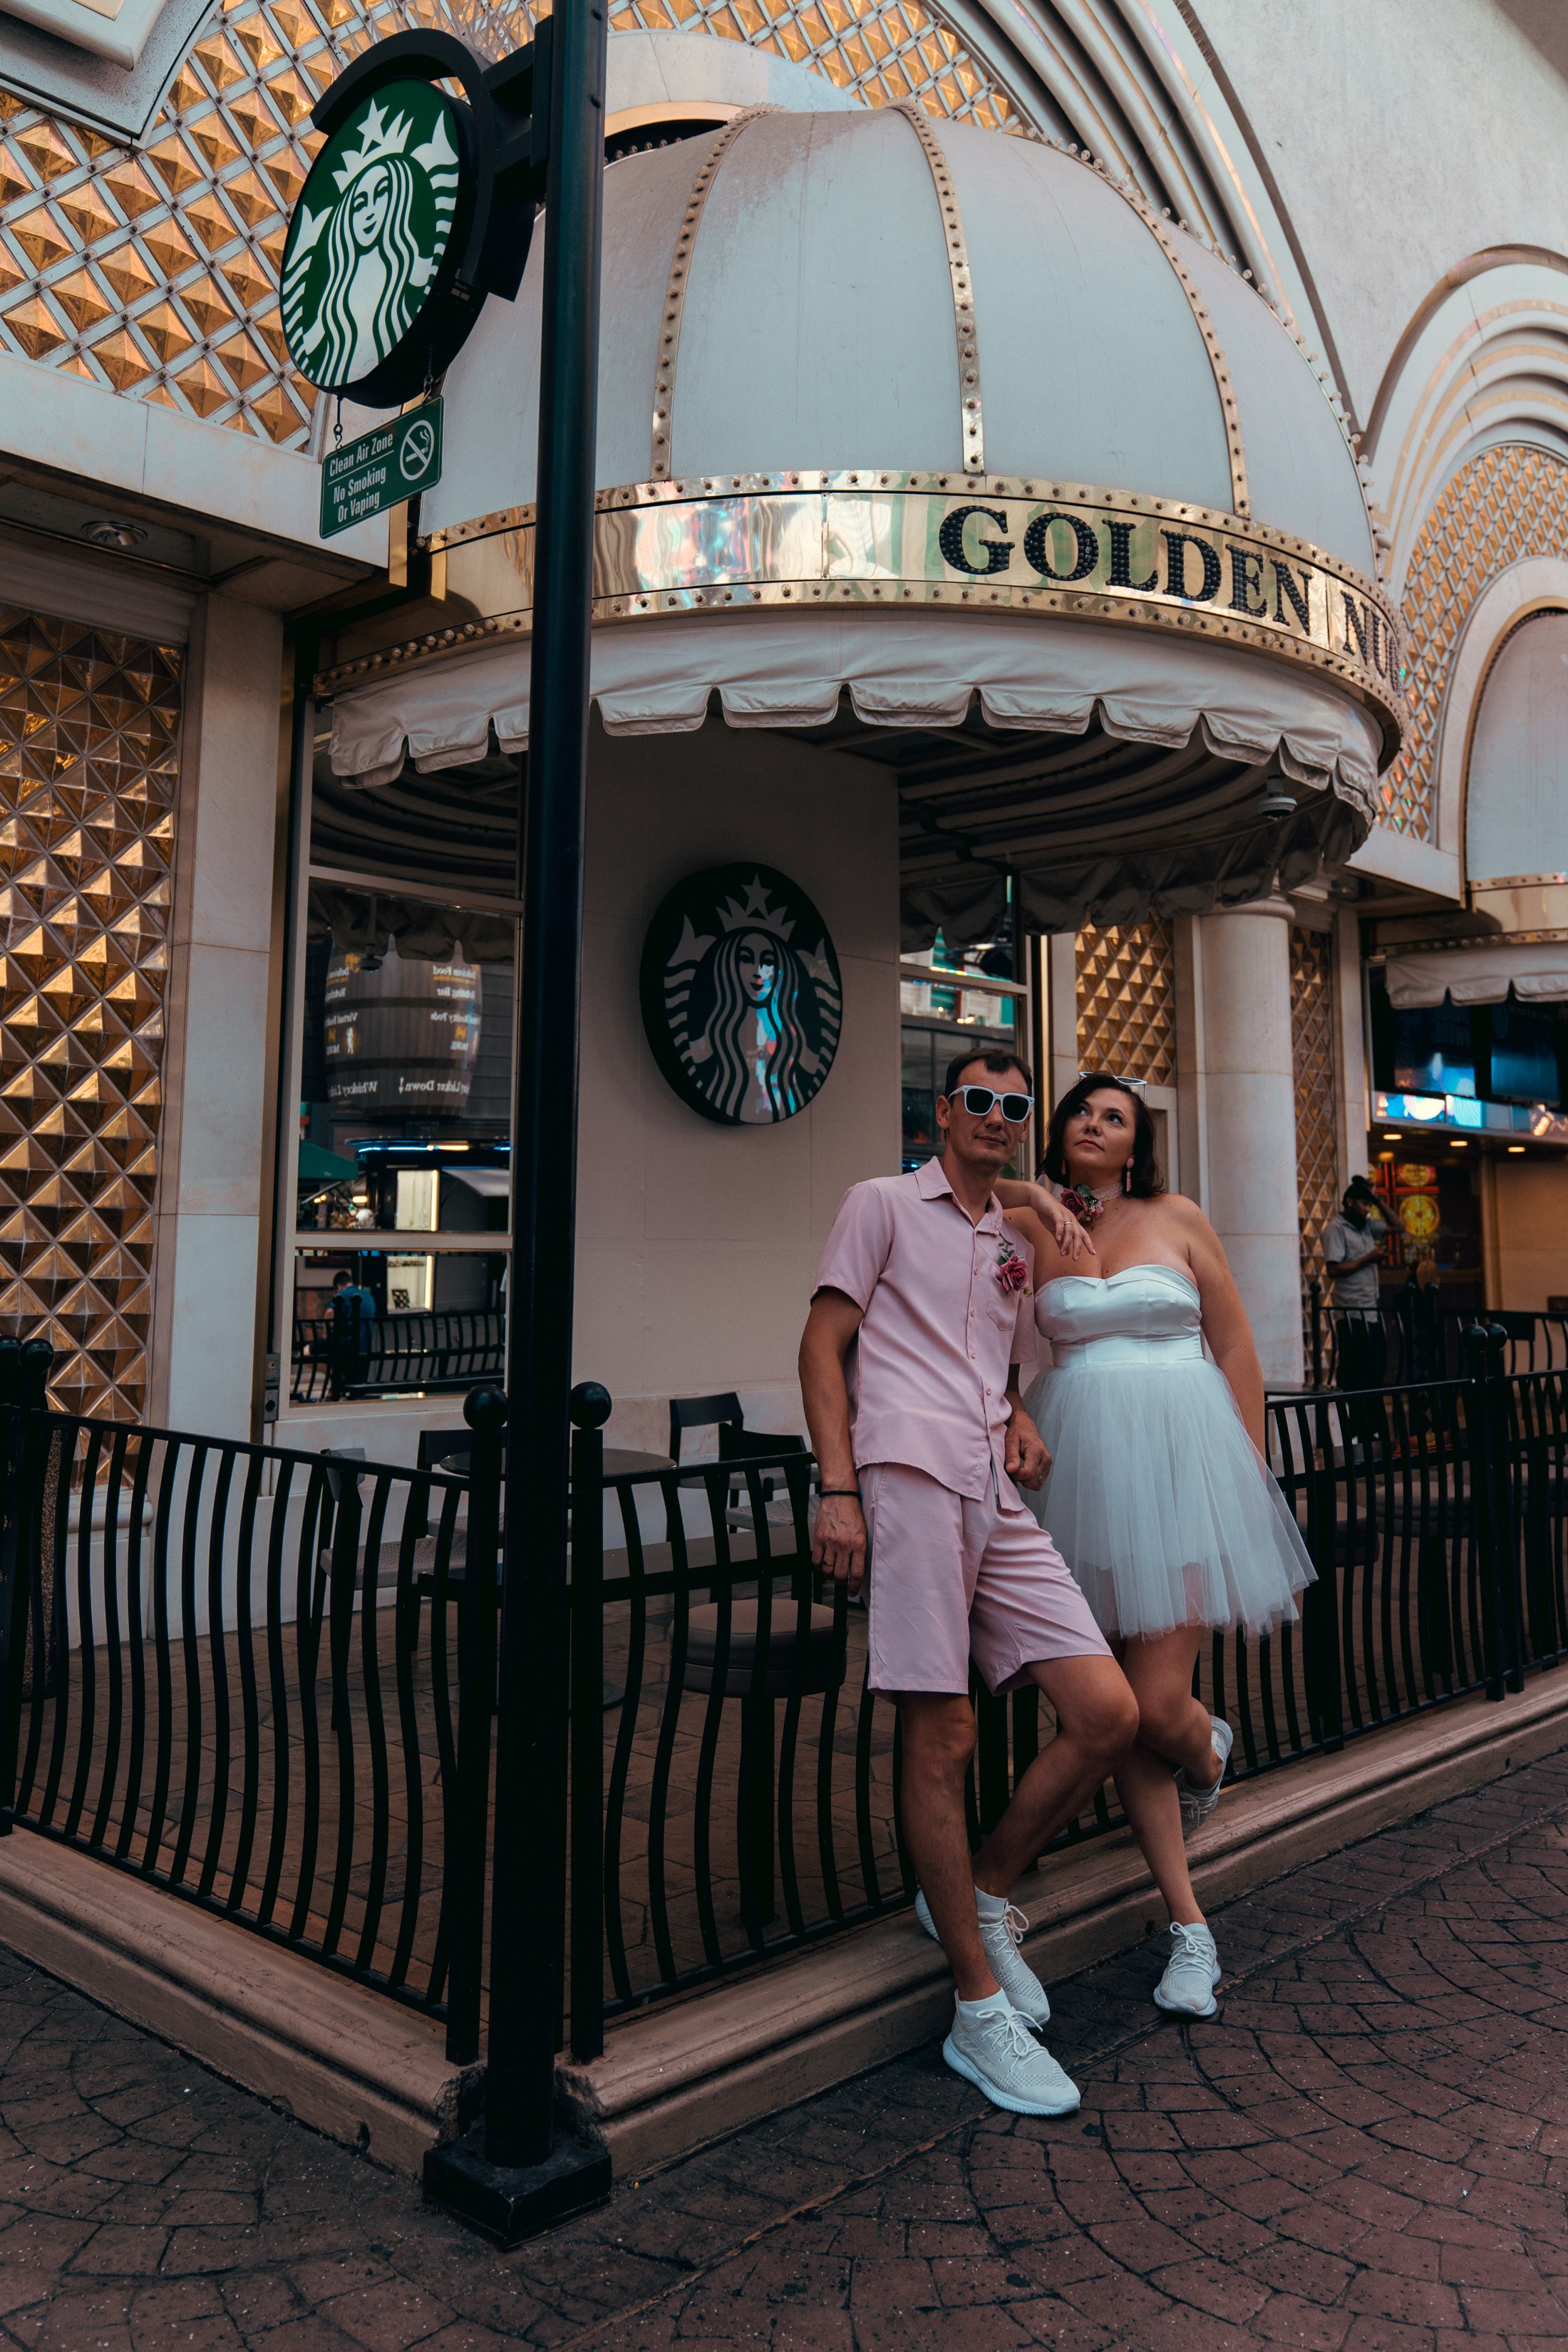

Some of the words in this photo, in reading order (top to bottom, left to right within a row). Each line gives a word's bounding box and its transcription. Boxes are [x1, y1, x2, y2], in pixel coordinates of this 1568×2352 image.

[329, 455, 354, 477] Clean
[356, 443, 370, 464] Air
[371, 433, 393, 455] Zone
[333, 485, 346, 504] No
[348, 466, 386, 497] Smoking
[337, 505, 349, 523] Or
[350, 491, 380, 516] Vaping
[939, 505, 1314, 636] GOLDEN
